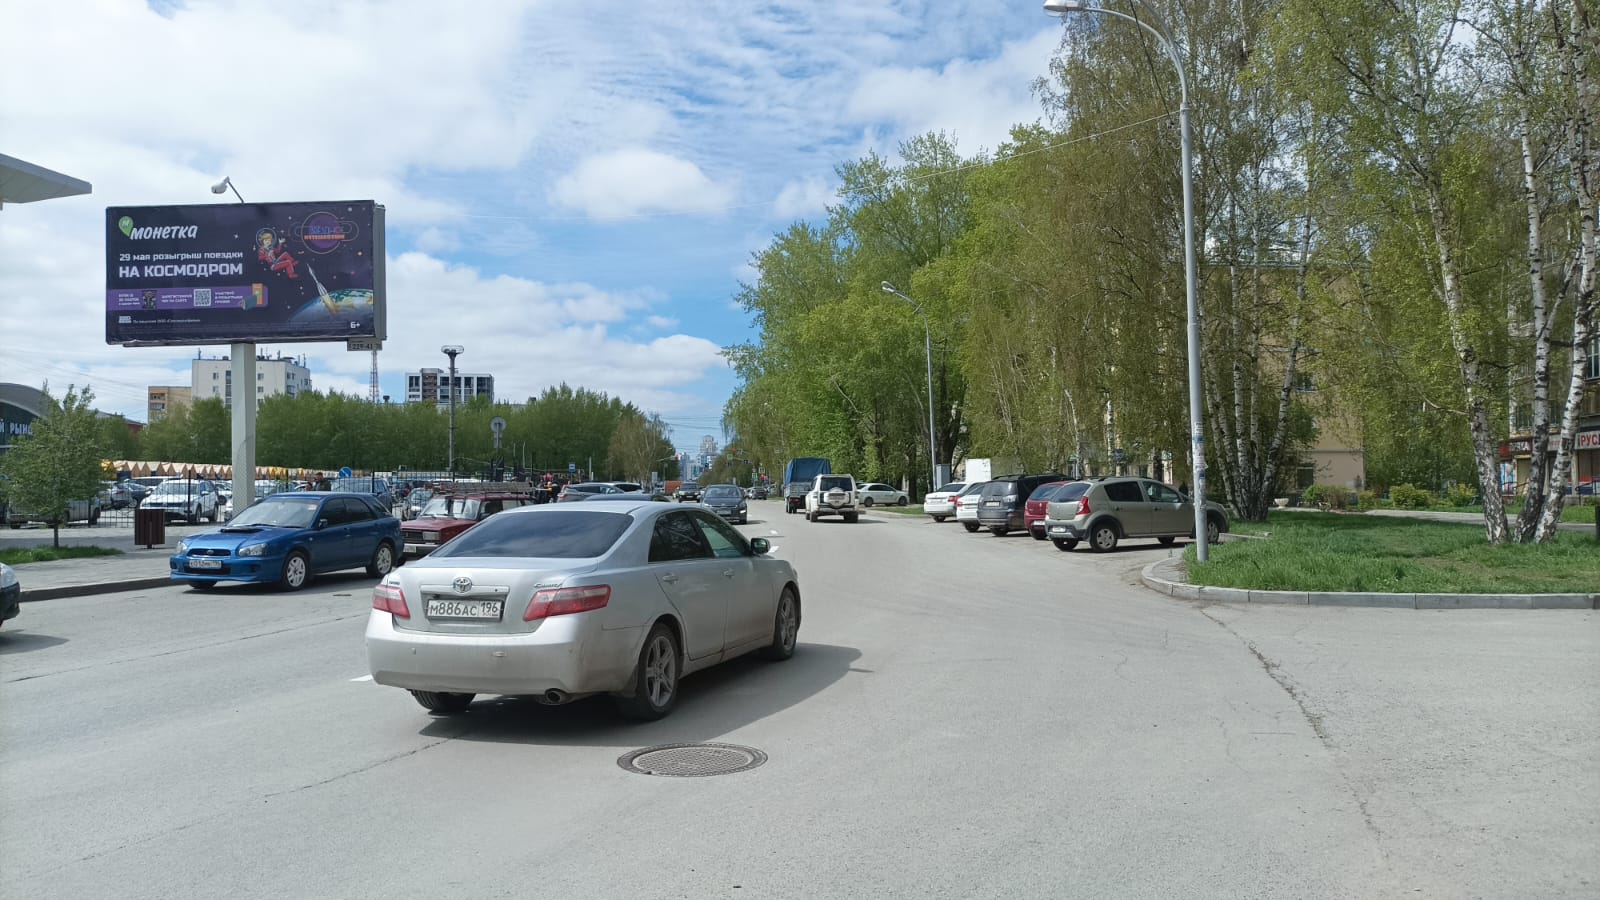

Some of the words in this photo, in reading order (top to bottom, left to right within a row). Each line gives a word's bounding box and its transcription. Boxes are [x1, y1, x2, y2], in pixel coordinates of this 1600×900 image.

[119, 253, 130, 261] 29
[153, 252, 202, 262] розыгрыш
[204, 251, 243, 260] поездки
[119, 265, 140, 278] НА
[144, 263, 243, 278] КОСМОДРОМ
[350, 321, 361, 329] 6+
[1580, 433, 1600, 447] РУС
[429, 601, 477, 616] М886АС
[481, 602, 498, 613] 196
